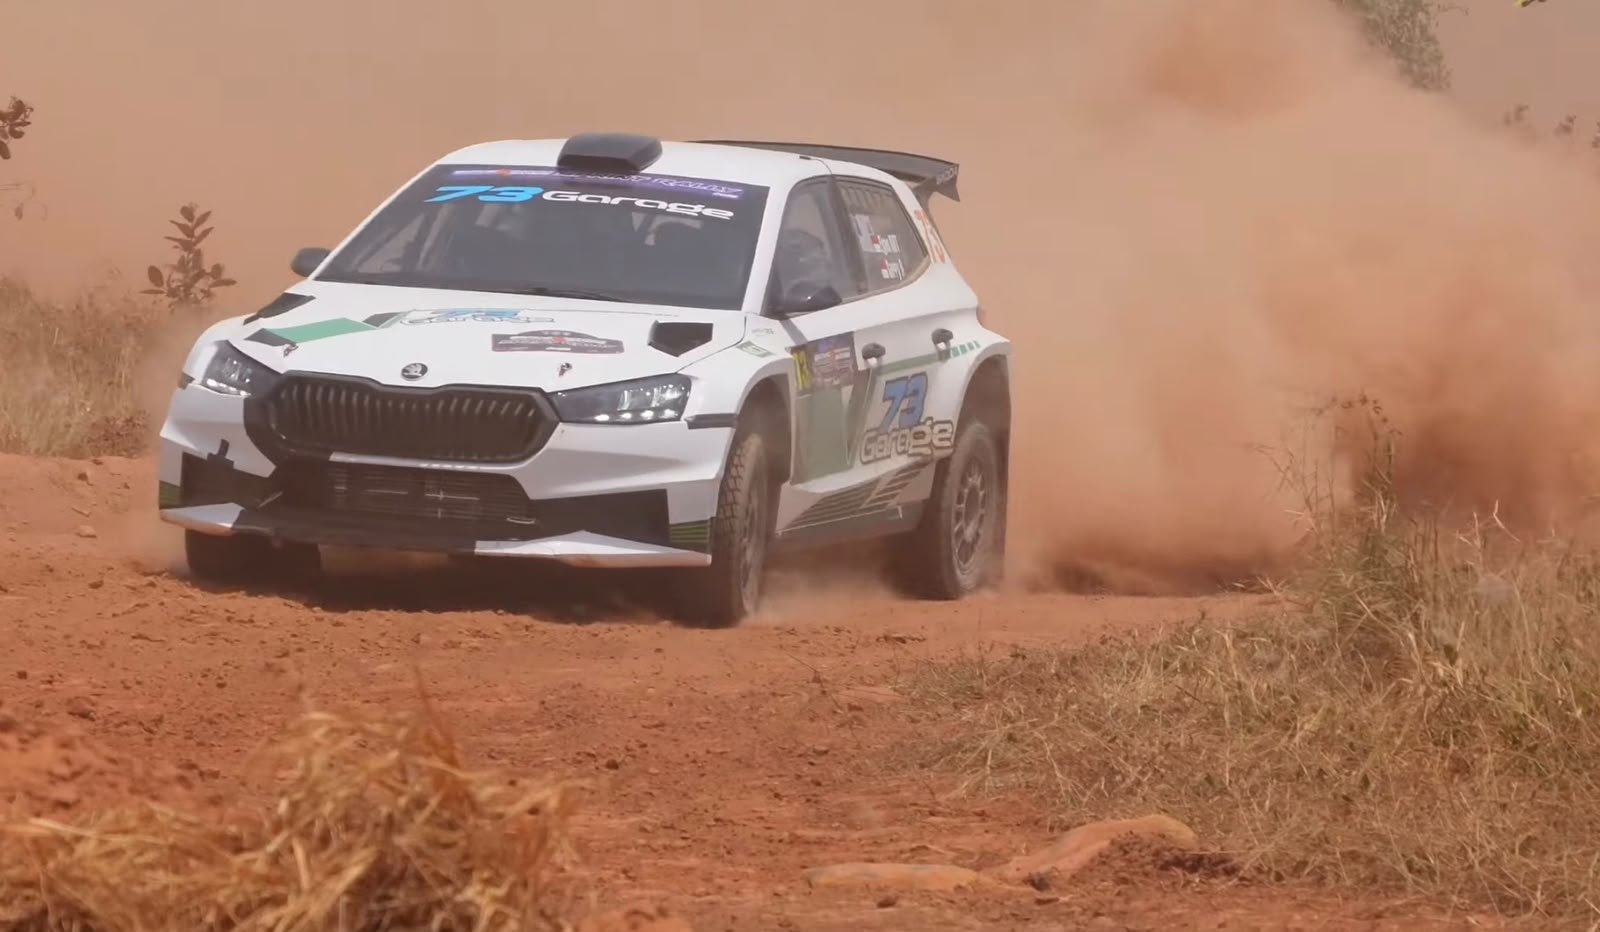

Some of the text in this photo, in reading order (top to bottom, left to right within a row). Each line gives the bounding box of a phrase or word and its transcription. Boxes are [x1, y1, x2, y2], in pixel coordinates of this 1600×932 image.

[423, 186, 735, 220] 73 Garage
[880, 370, 928, 434] 73
[860, 416, 954, 465] Garage
